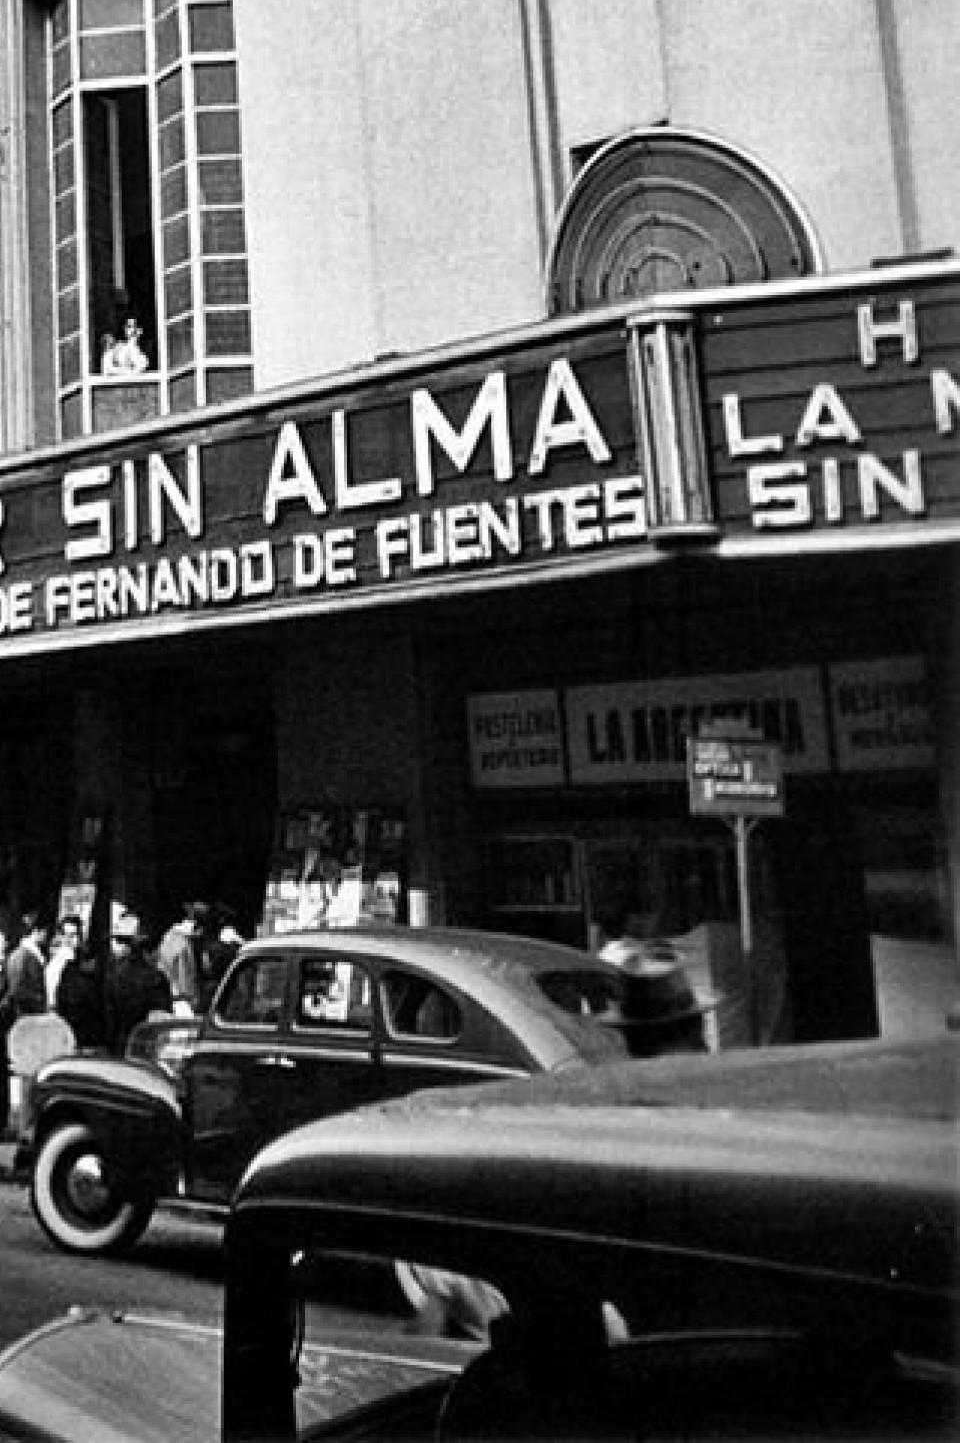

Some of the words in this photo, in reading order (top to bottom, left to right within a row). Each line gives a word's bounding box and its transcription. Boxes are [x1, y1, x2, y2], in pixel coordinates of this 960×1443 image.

[62, 444, 203, 560] SIN
[263, 358, 613, 525] ALMA
[722, 382, 864, 458] LA
[746, 448, 927, 528] SIN
[44, 540, 275, 627] FERNANDO
[292, 528, 358, 589] DE
[374, 473, 644, 579] FUENTES
